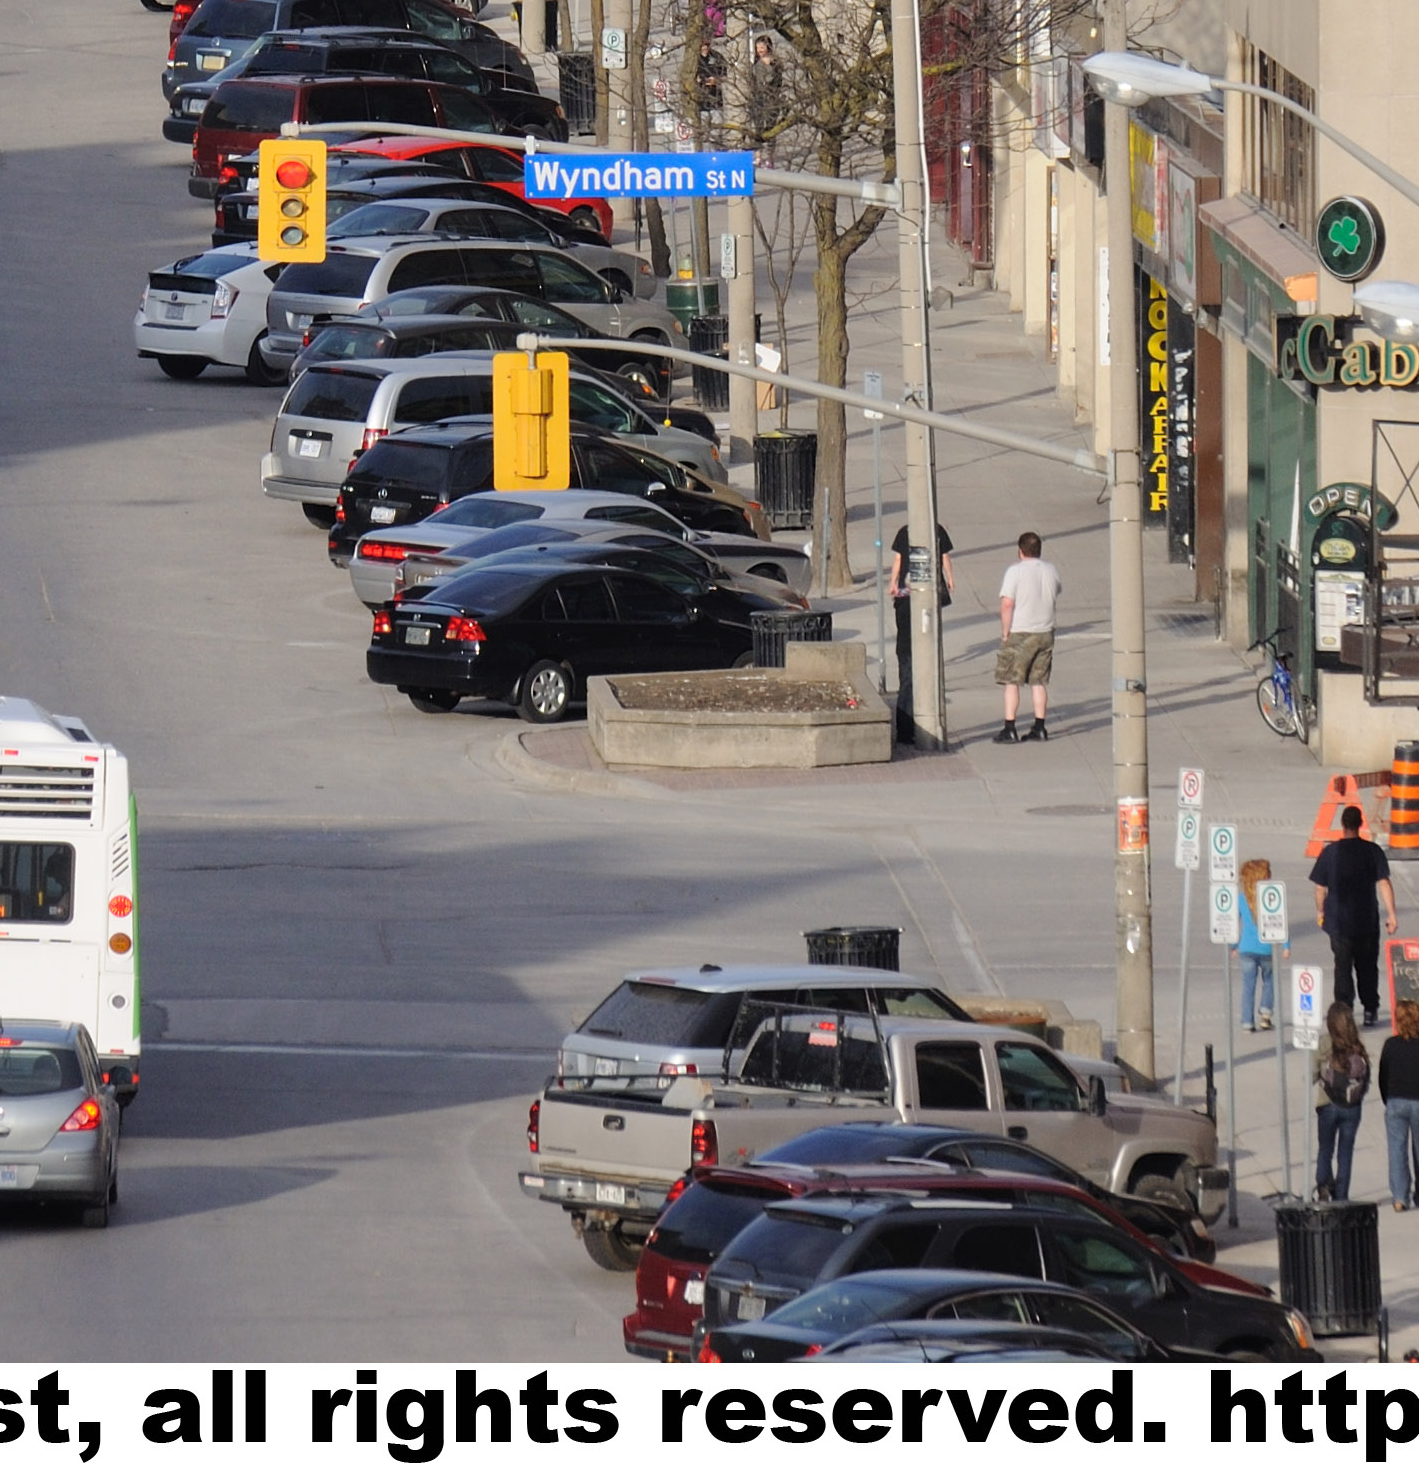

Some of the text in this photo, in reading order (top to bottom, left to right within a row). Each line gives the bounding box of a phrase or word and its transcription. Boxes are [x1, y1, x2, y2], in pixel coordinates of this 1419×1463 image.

[533, 160, 745, 198] Wyndham St N
[1149, 395, 1168, 512] AFFAIR
[1308, 488, 1379, 517] OPEN
